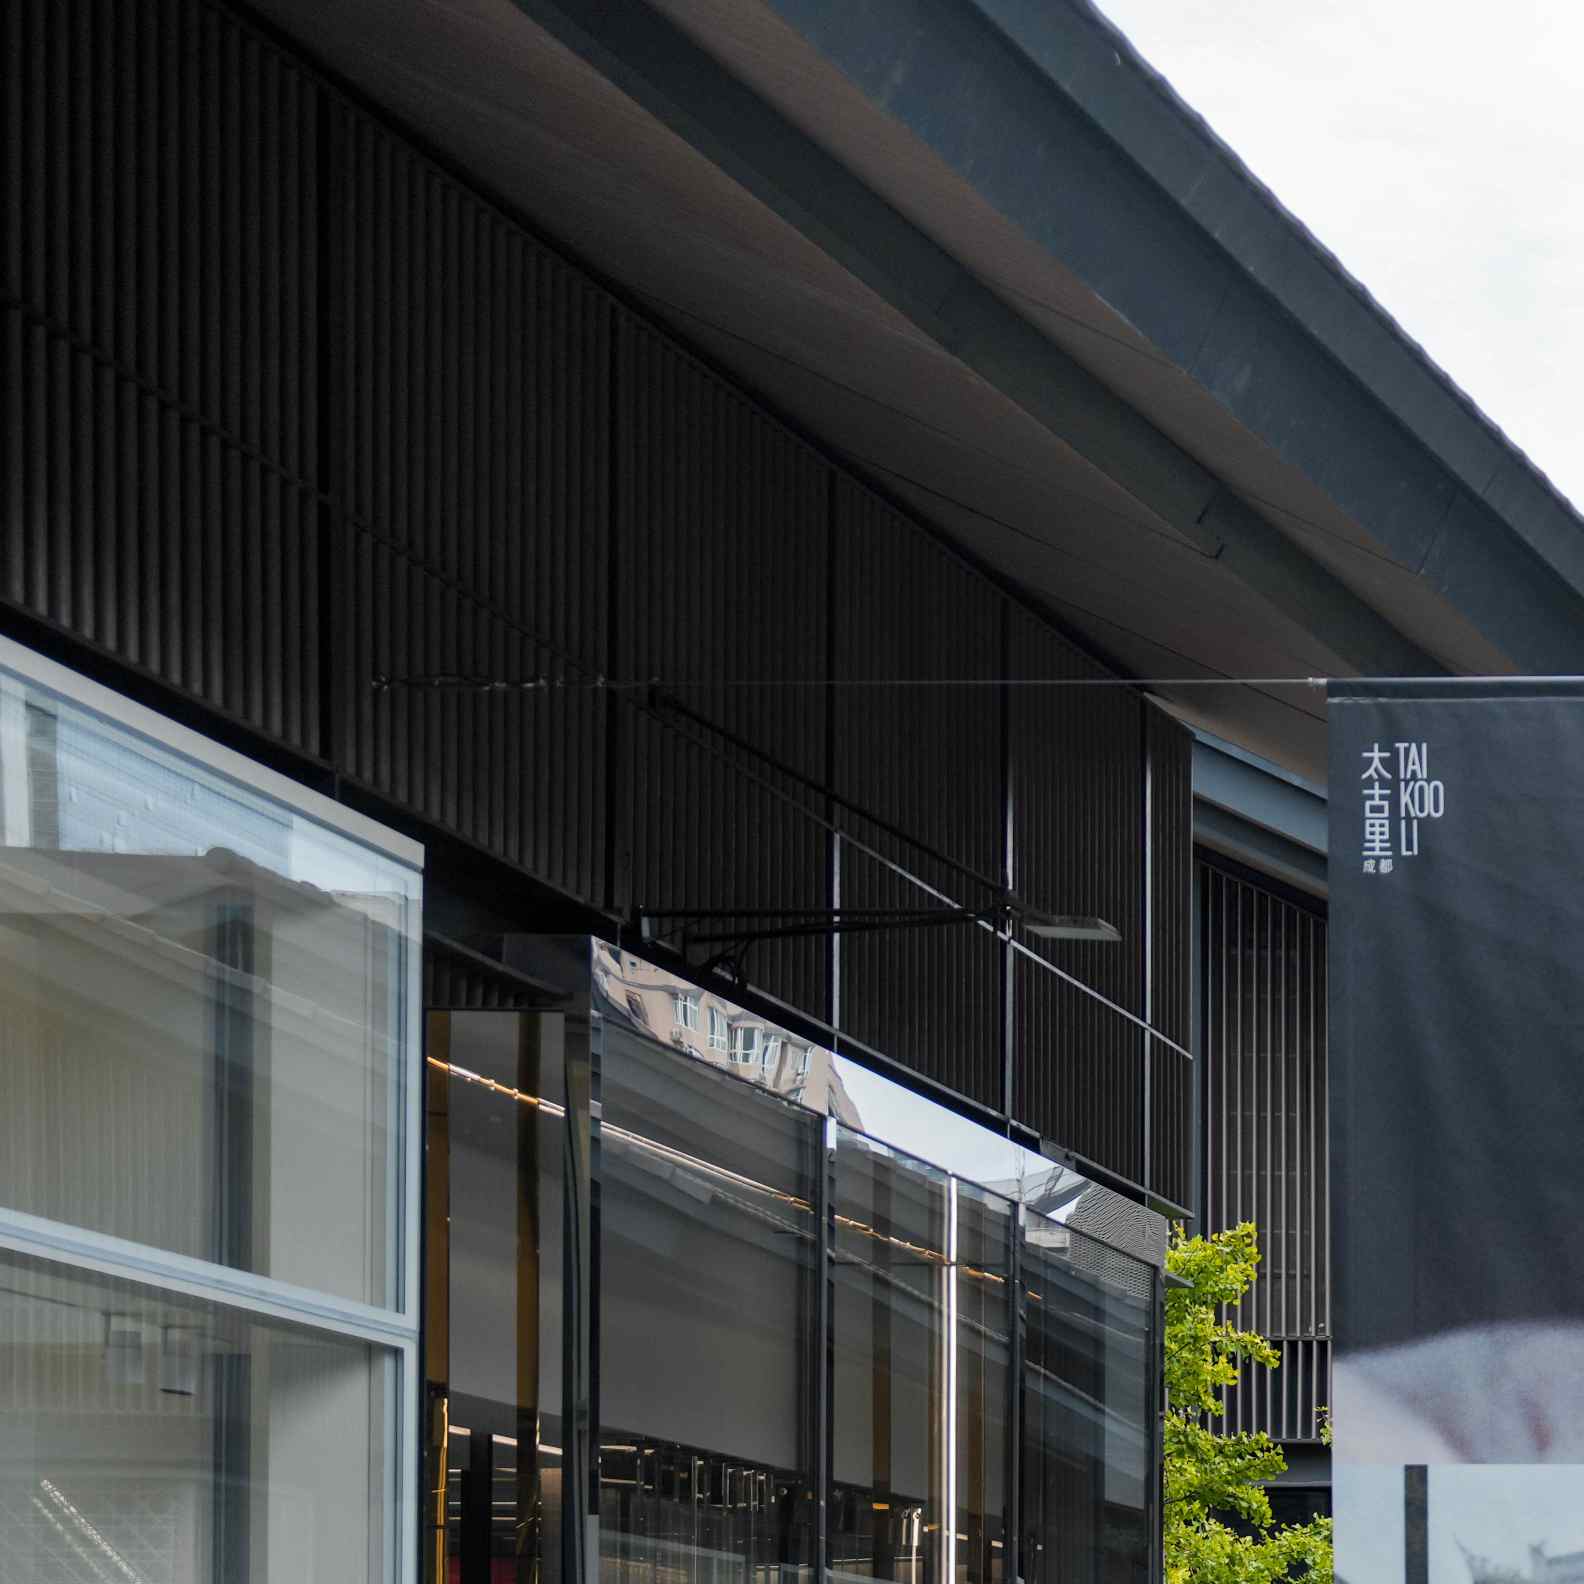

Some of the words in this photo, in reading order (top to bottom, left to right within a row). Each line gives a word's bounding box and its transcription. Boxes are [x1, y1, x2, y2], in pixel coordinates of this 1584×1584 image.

[1395, 743, 1428, 779] TAI
[1361, 743, 1392, 856] 太古里
[1400, 781, 1445, 818] KOO
[1401, 819, 1418, 856] LI
[1362, 858, 1393, 873] 成都
